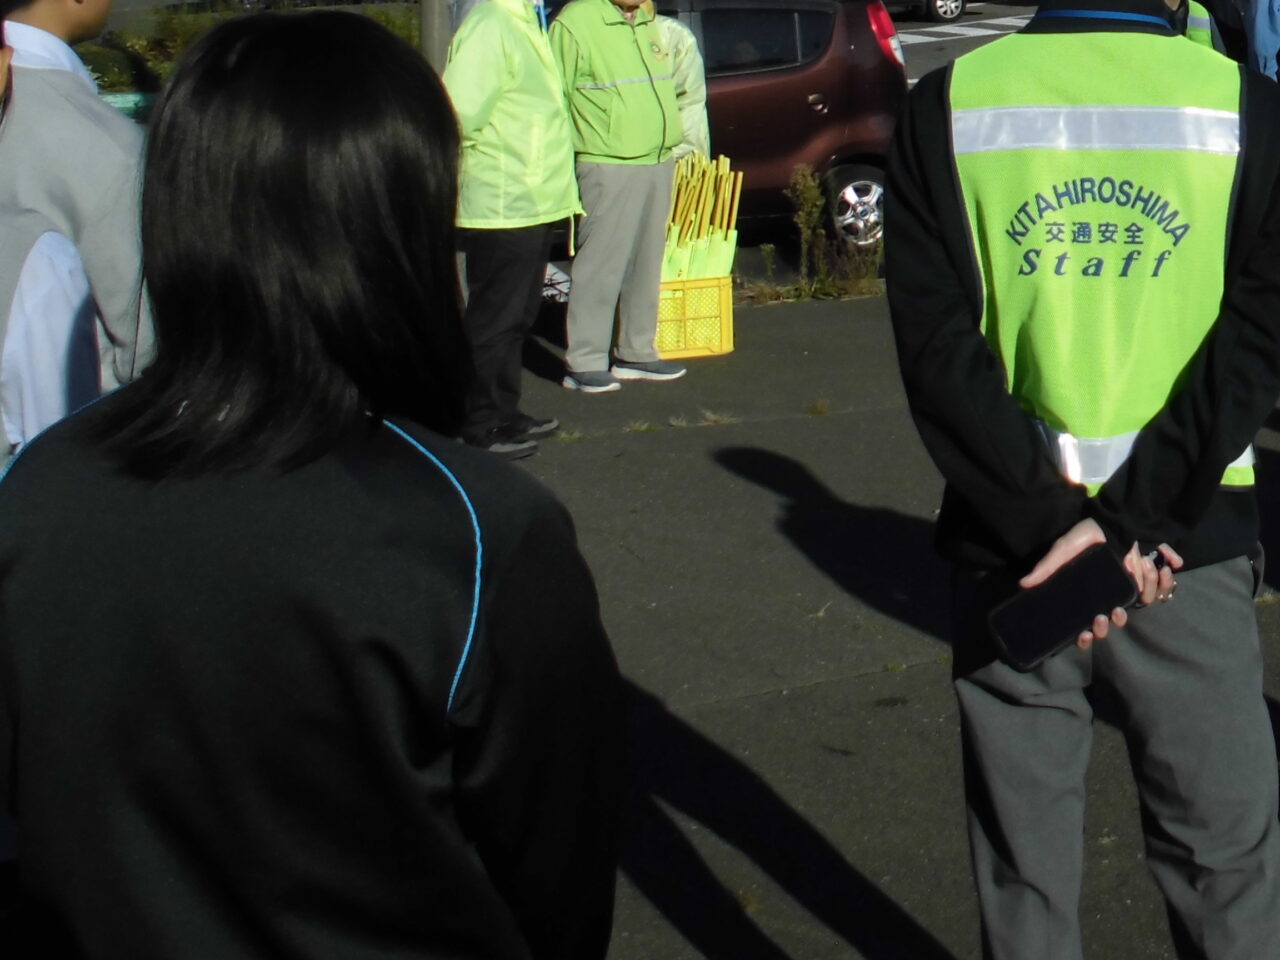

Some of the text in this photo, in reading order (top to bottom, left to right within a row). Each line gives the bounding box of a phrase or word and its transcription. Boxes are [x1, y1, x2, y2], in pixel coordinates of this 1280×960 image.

[1005, 176, 1191, 247] KITAHIROSHIMA
[1045, 221, 1144, 245] 交通安全
[1018, 248, 1173, 278] Staff
